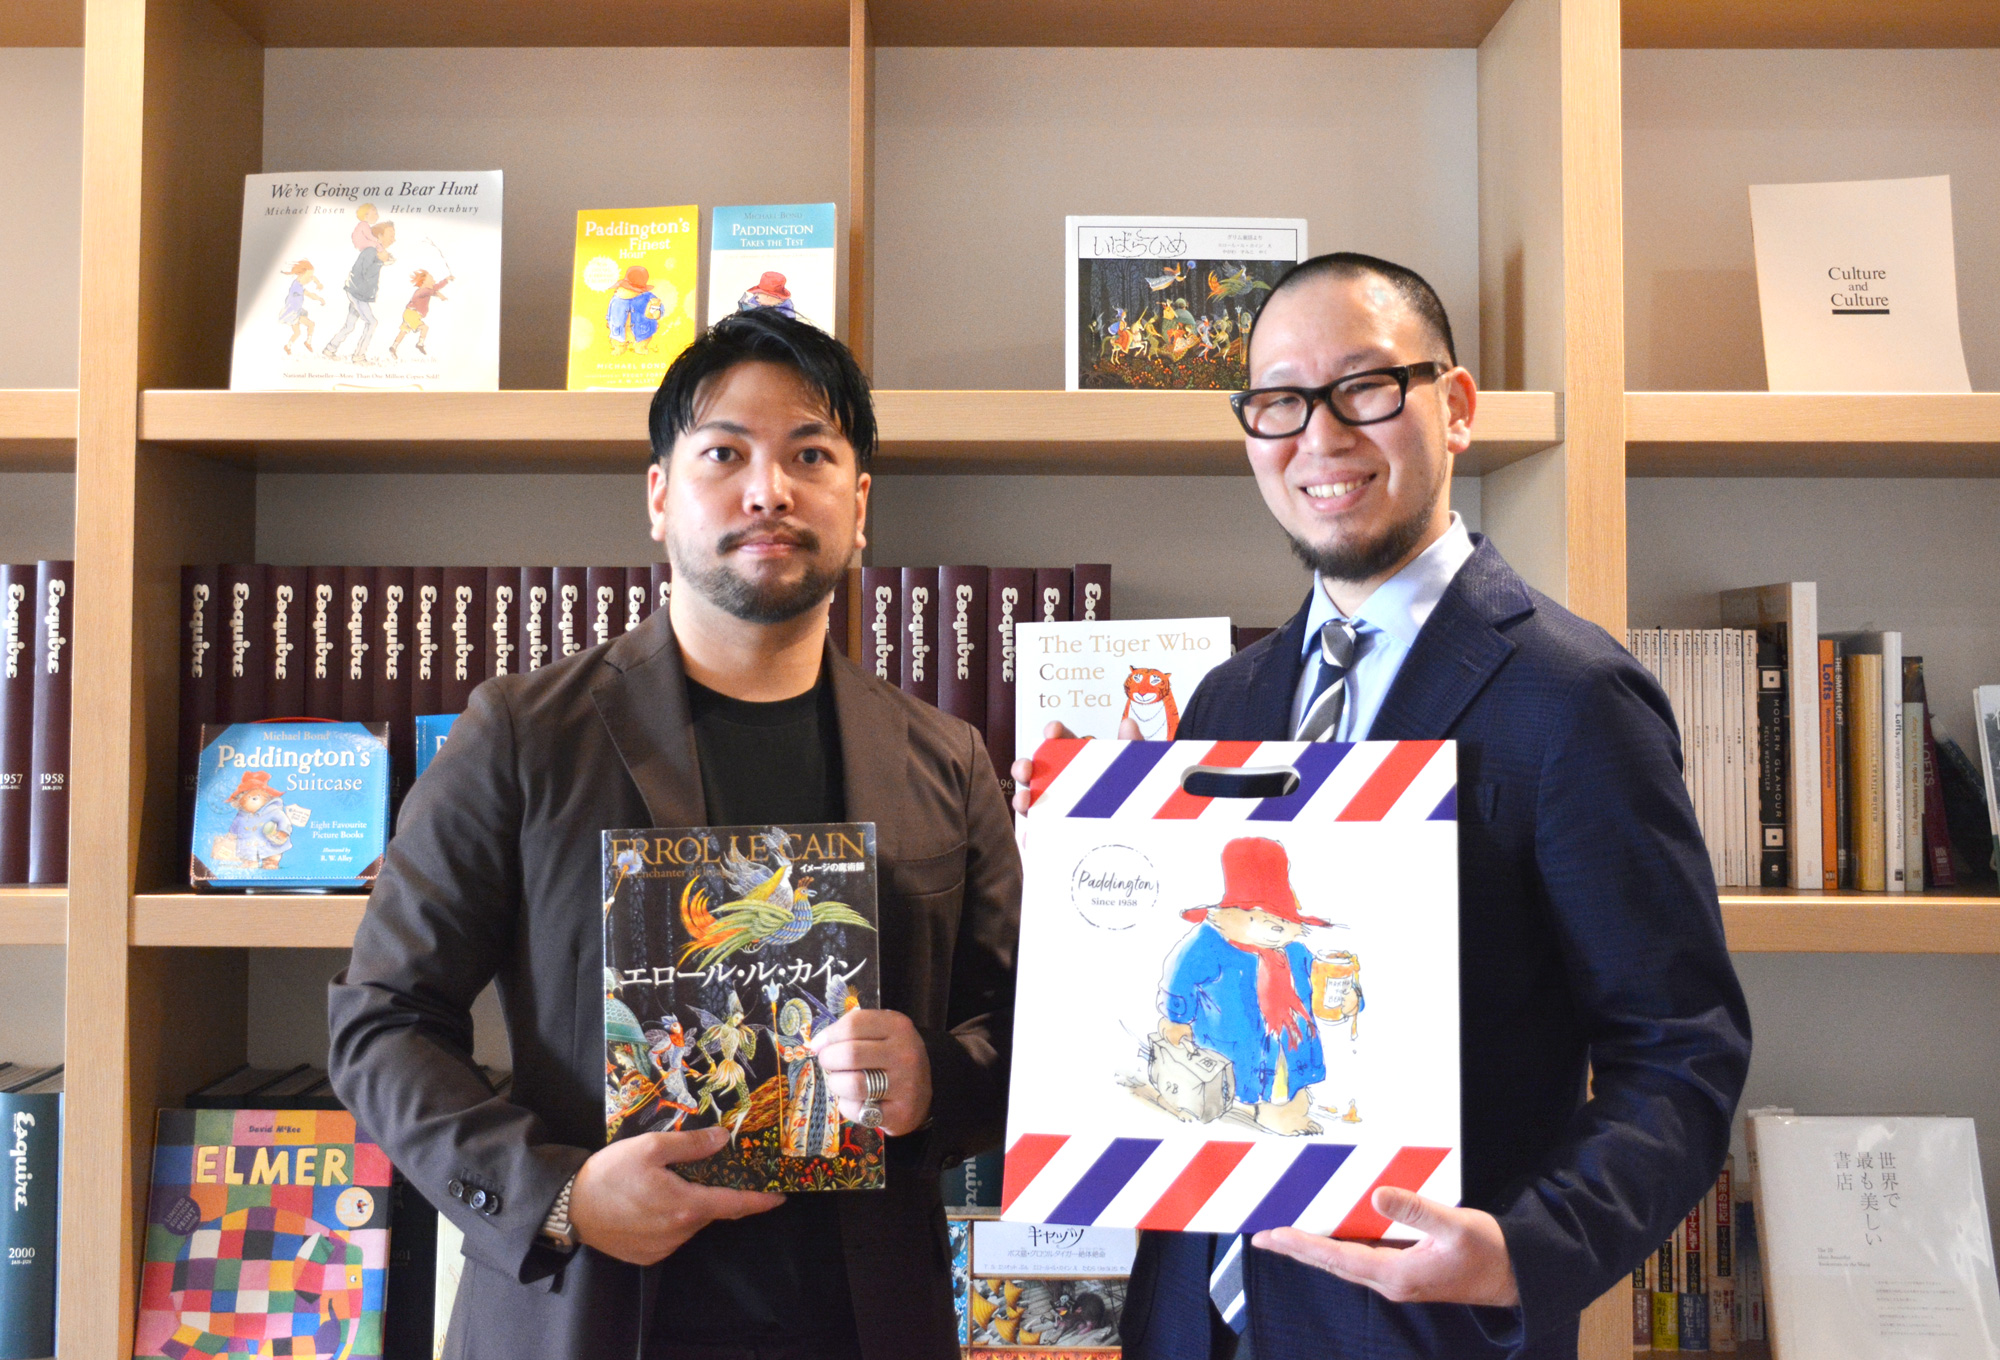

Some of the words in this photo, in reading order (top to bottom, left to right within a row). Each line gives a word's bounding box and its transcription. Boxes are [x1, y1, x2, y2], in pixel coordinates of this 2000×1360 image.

[271, 183, 309, 199] We're
[314, 182, 360, 201] Going
[362, 184, 381, 197] on
[384, 185, 394, 197] a
[399, 181, 436, 197] Bear
[438, 181, 480, 196] Hunt
[264, 206, 309, 216] Michael
[313, 205, 346, 215] Rosen
[390, 204, 423, 214] Helen
[427, 204, 480, 216] Oxenbury
[584, 217, 691, 240] Paddington's
[731, 223, 814, 236] PADDINGTON
[619, 248, 647, 259] Hour
[629, 237, 672, 251] Finest
[1828, 266, 1887, 281] Culture
[1848, 281, 1869, 292] and
[1830, 293, 1889, 307] Culture
[2, 583, 25, 678] Esquire
[44, 579, 66, 674] Esquire
[189, 583, 210, 678] Esquire
[229, 583, 250, 678] Esquire
[273, 585, 294, 680] Esquire
[312, 584, 334, 679] Esquire
[347, 585, 369, 680] Esquire
[383, 585, 404, 680] Esquire
[416, 585, 438, 680] Esquire
[452, 585, 474, 681] Esquire
[526, 586, 548, 672] Esquir
[871, 585, 893, 681] Esquire
[908, 586, 930, 683] Esquire
[952, 584, 975, 680] Esquire
[1038, 635, 1082, 655] The
[1088, 635, 1150, 657] Tiger
[1156, 633, 1212, 652] Who
[1038, 662, 1105, 681] Came
[1822, 663, 1832, 701] Lofts
[1038, 691, 1062, 708] to
[1067, 690, 1113, 708] Tea
[263, 731, 301, 741] Michael
[303, 731, 331, 741] Bond
[218, 745, 371, 774] Paddington's
[0, 773, 24, 785] 1957
[40, 773, 65, 785] 1958
[286, 773, 363, 792] Suitcase
[1774, 759, 1782, 819] GLAMOUR
[310, 820, 331, 830] Eight
[332, 820, 368, 829] Favourite
[312, 830, 339, 839] Picture
[340, 830, 364, 839] Books
[337, 855, 353, 863] Alley
[611, 837, 721, 866] ERROL
[729, 835, 770, 862] LE
[780, 833, 865, 861] CAIN
[635, 867, 686, 879] Enchanter
[800, 862, 865, 872] イメージの魔術師
[1078, 869, 1154, 898] Paddington
[1091, 897, 1116, 906] Since
[1118, 898, 1138, 906] 1958
[619, 954, 867, 990] エロール・ル・カイン
[249, 1125, 273, 1134] David
[10, 1111, 36, 1212] Esquire
[196, 1145, 349, 1187] ELMER
[1833, 1151, 1853, 1191] 書店
[1878, 1151, 1901, 1209] 世界で
[165, 1197, 186, 1223] LIMITED
[1855, 1151, 1883, 1246] 最も美しい
[170, 1201, 191, 1228] EDITION
[177, 1208, 197, 1232] PRINT
[8, 1247, 36, 1259] 2000
